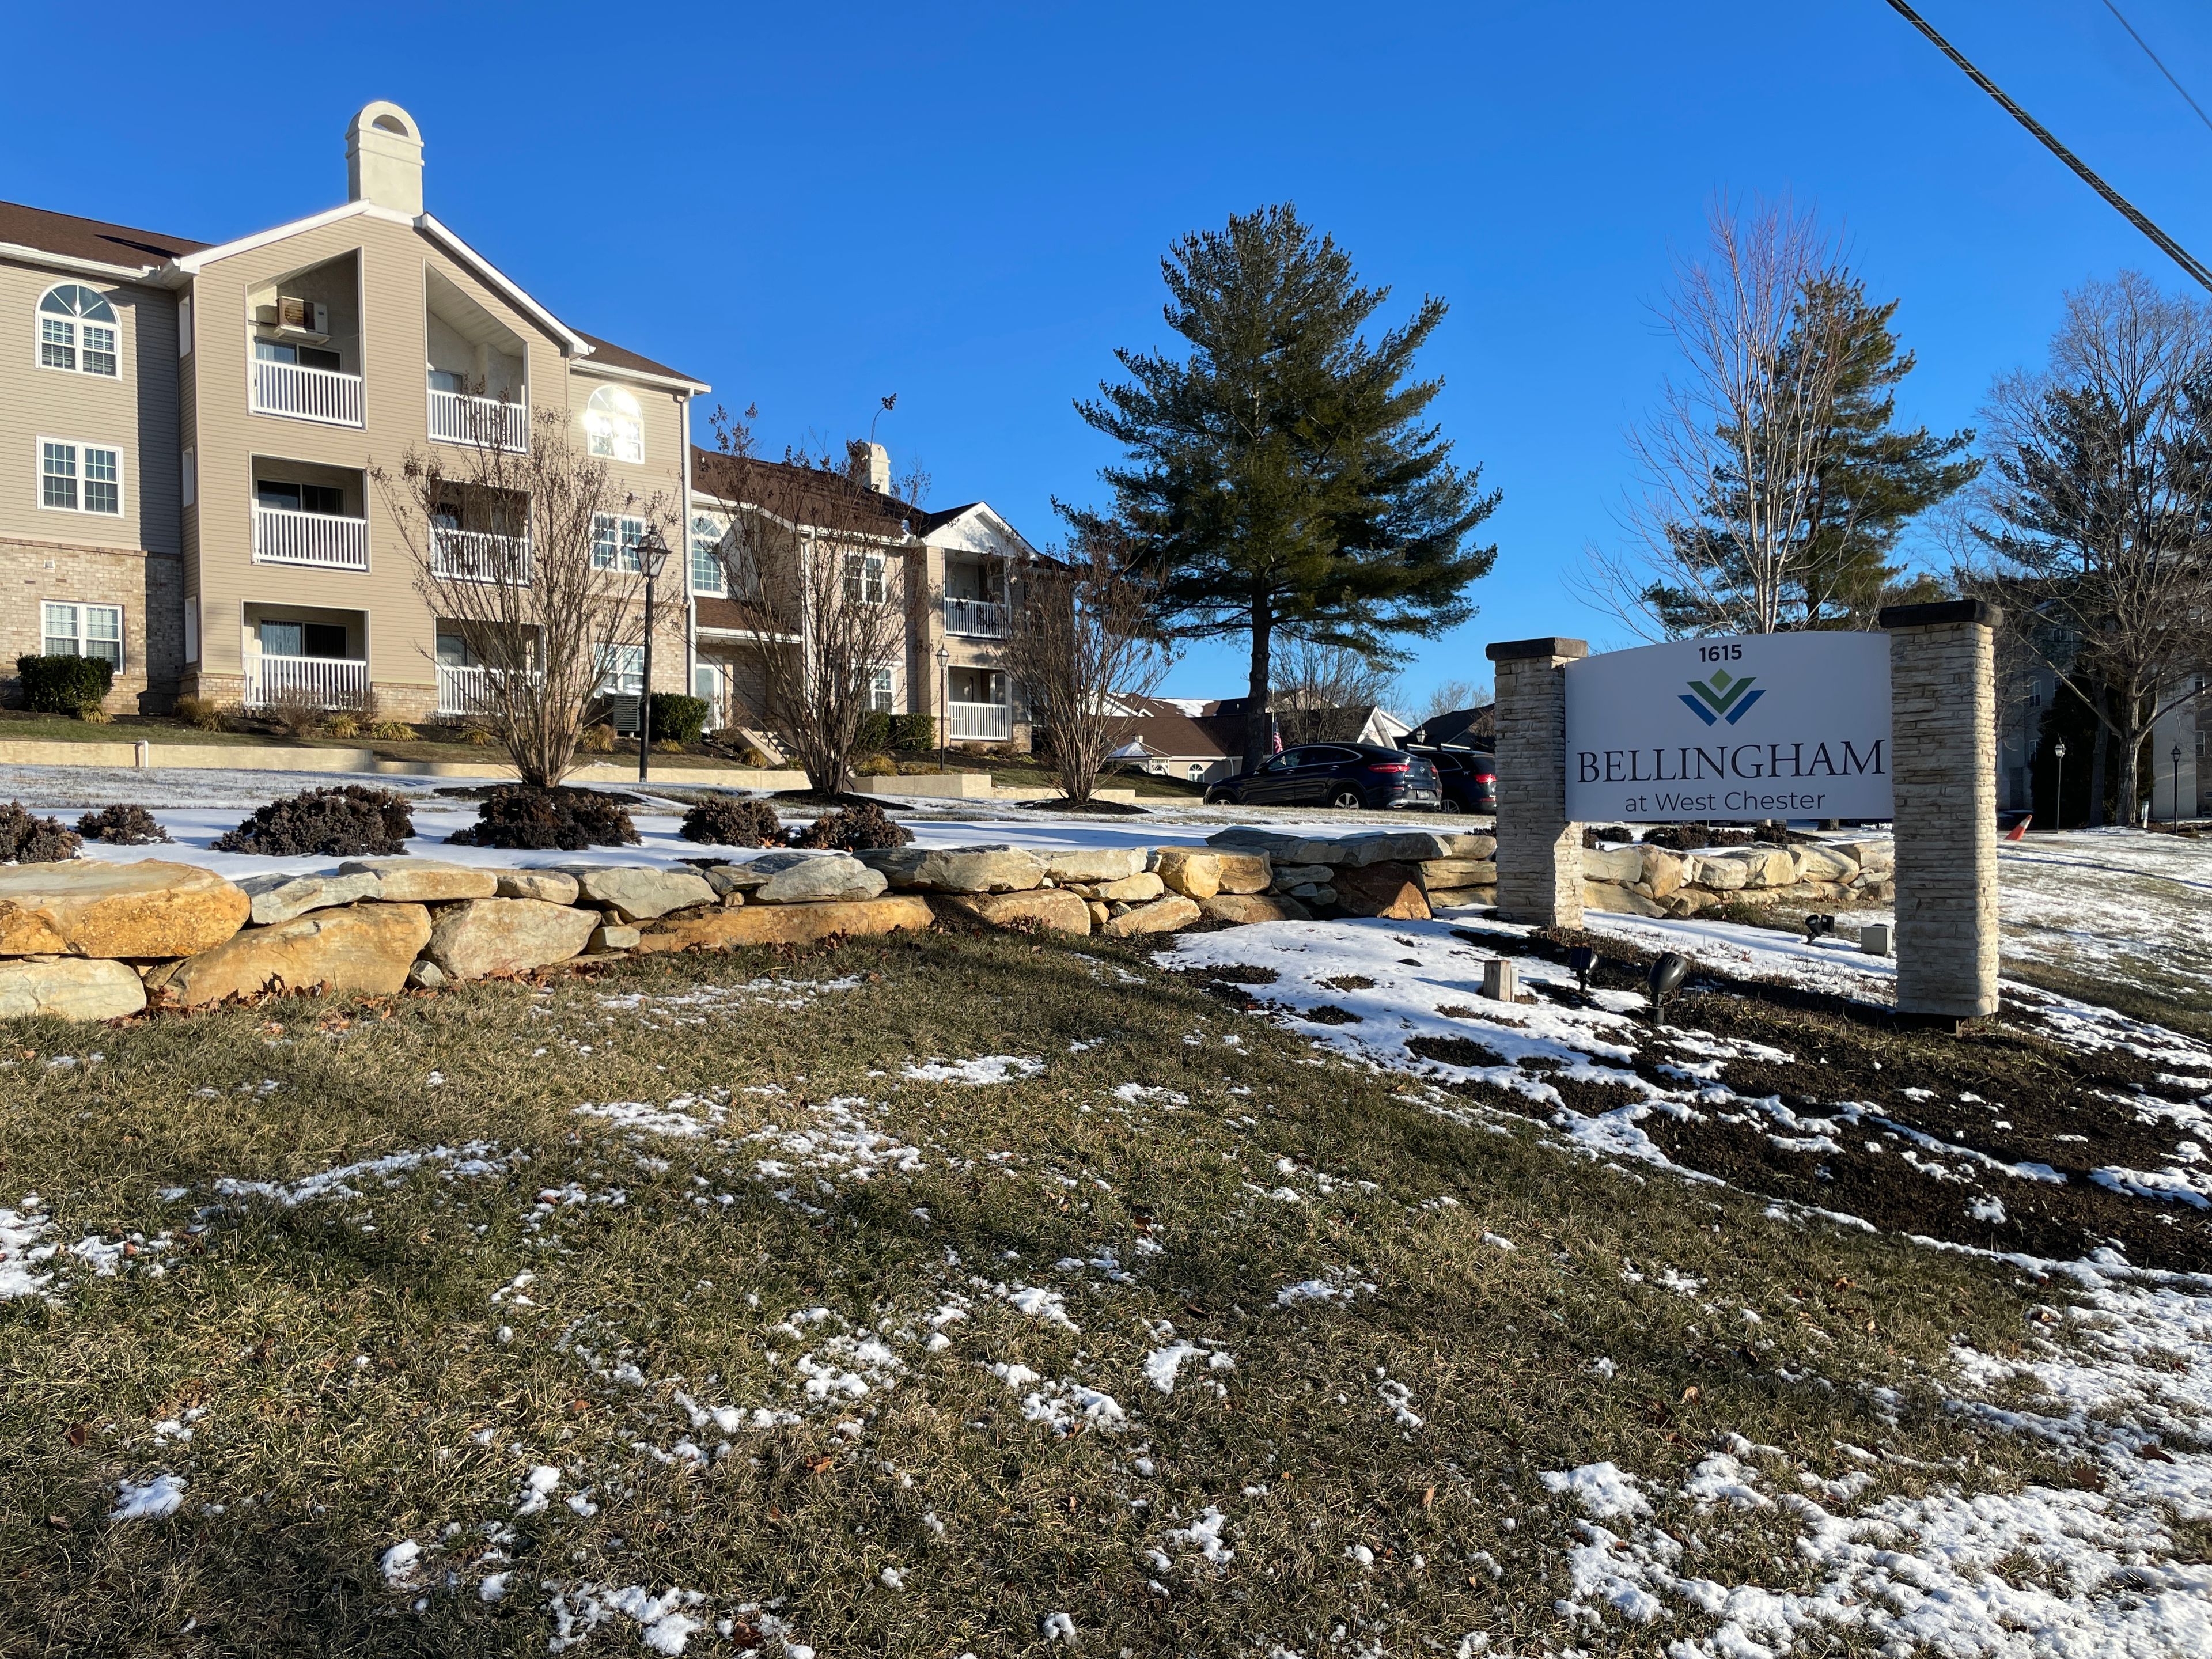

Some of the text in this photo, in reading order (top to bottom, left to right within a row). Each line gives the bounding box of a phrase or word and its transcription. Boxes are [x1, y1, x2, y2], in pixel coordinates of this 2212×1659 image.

[1699, 644, 1743, 662] 1615
[1577, 739, 1885, 783] BELLINGHAM
[1625, 790, 1825, 812] at West Chester
